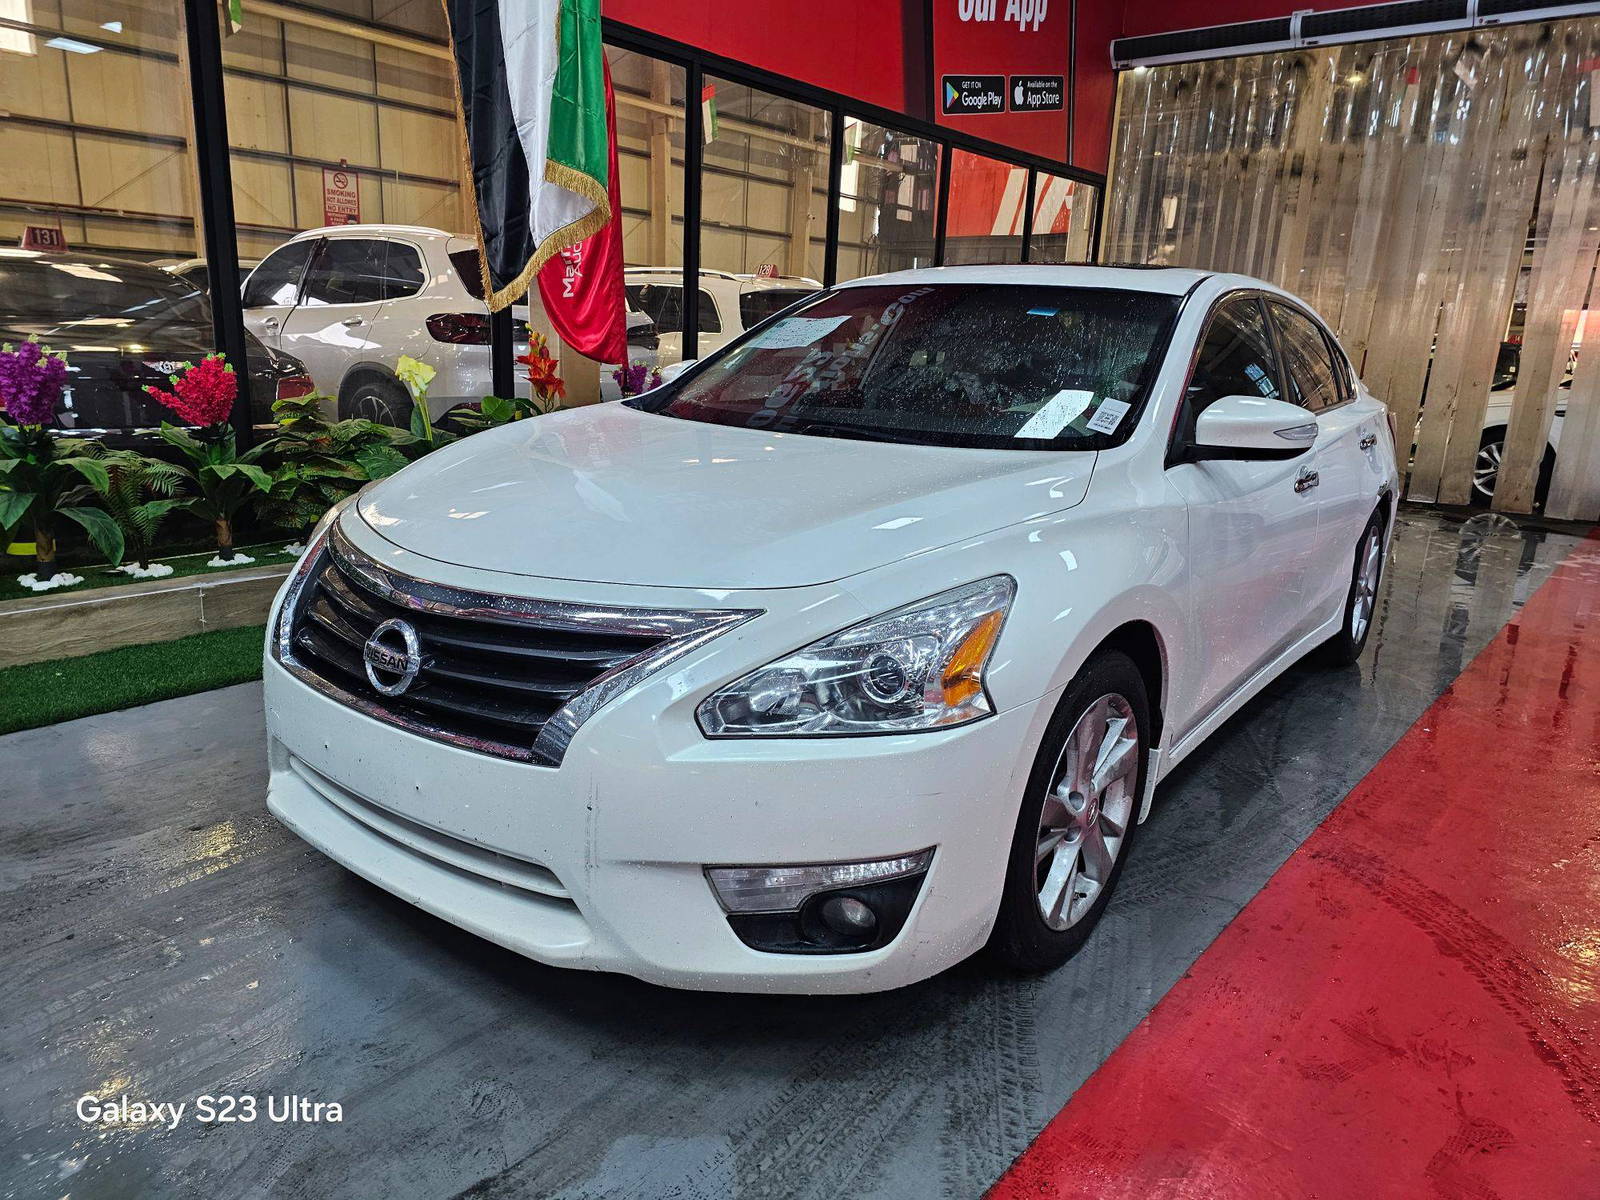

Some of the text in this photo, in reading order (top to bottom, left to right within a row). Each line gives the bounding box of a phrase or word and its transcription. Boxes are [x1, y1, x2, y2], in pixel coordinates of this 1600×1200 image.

[1004, 0, 1048, 32] App
[961, 81, 970, 89] GET
[961, 91, 1002, 109] Google Play
[1027, 90, 1060, 108] App Store
[326, 189, 356, 198] SMOKING
[337, 206, 357, 214] ENTRY
[35, 229, 58, 246] 131
[366, 645, 409, 671] NISSAN
